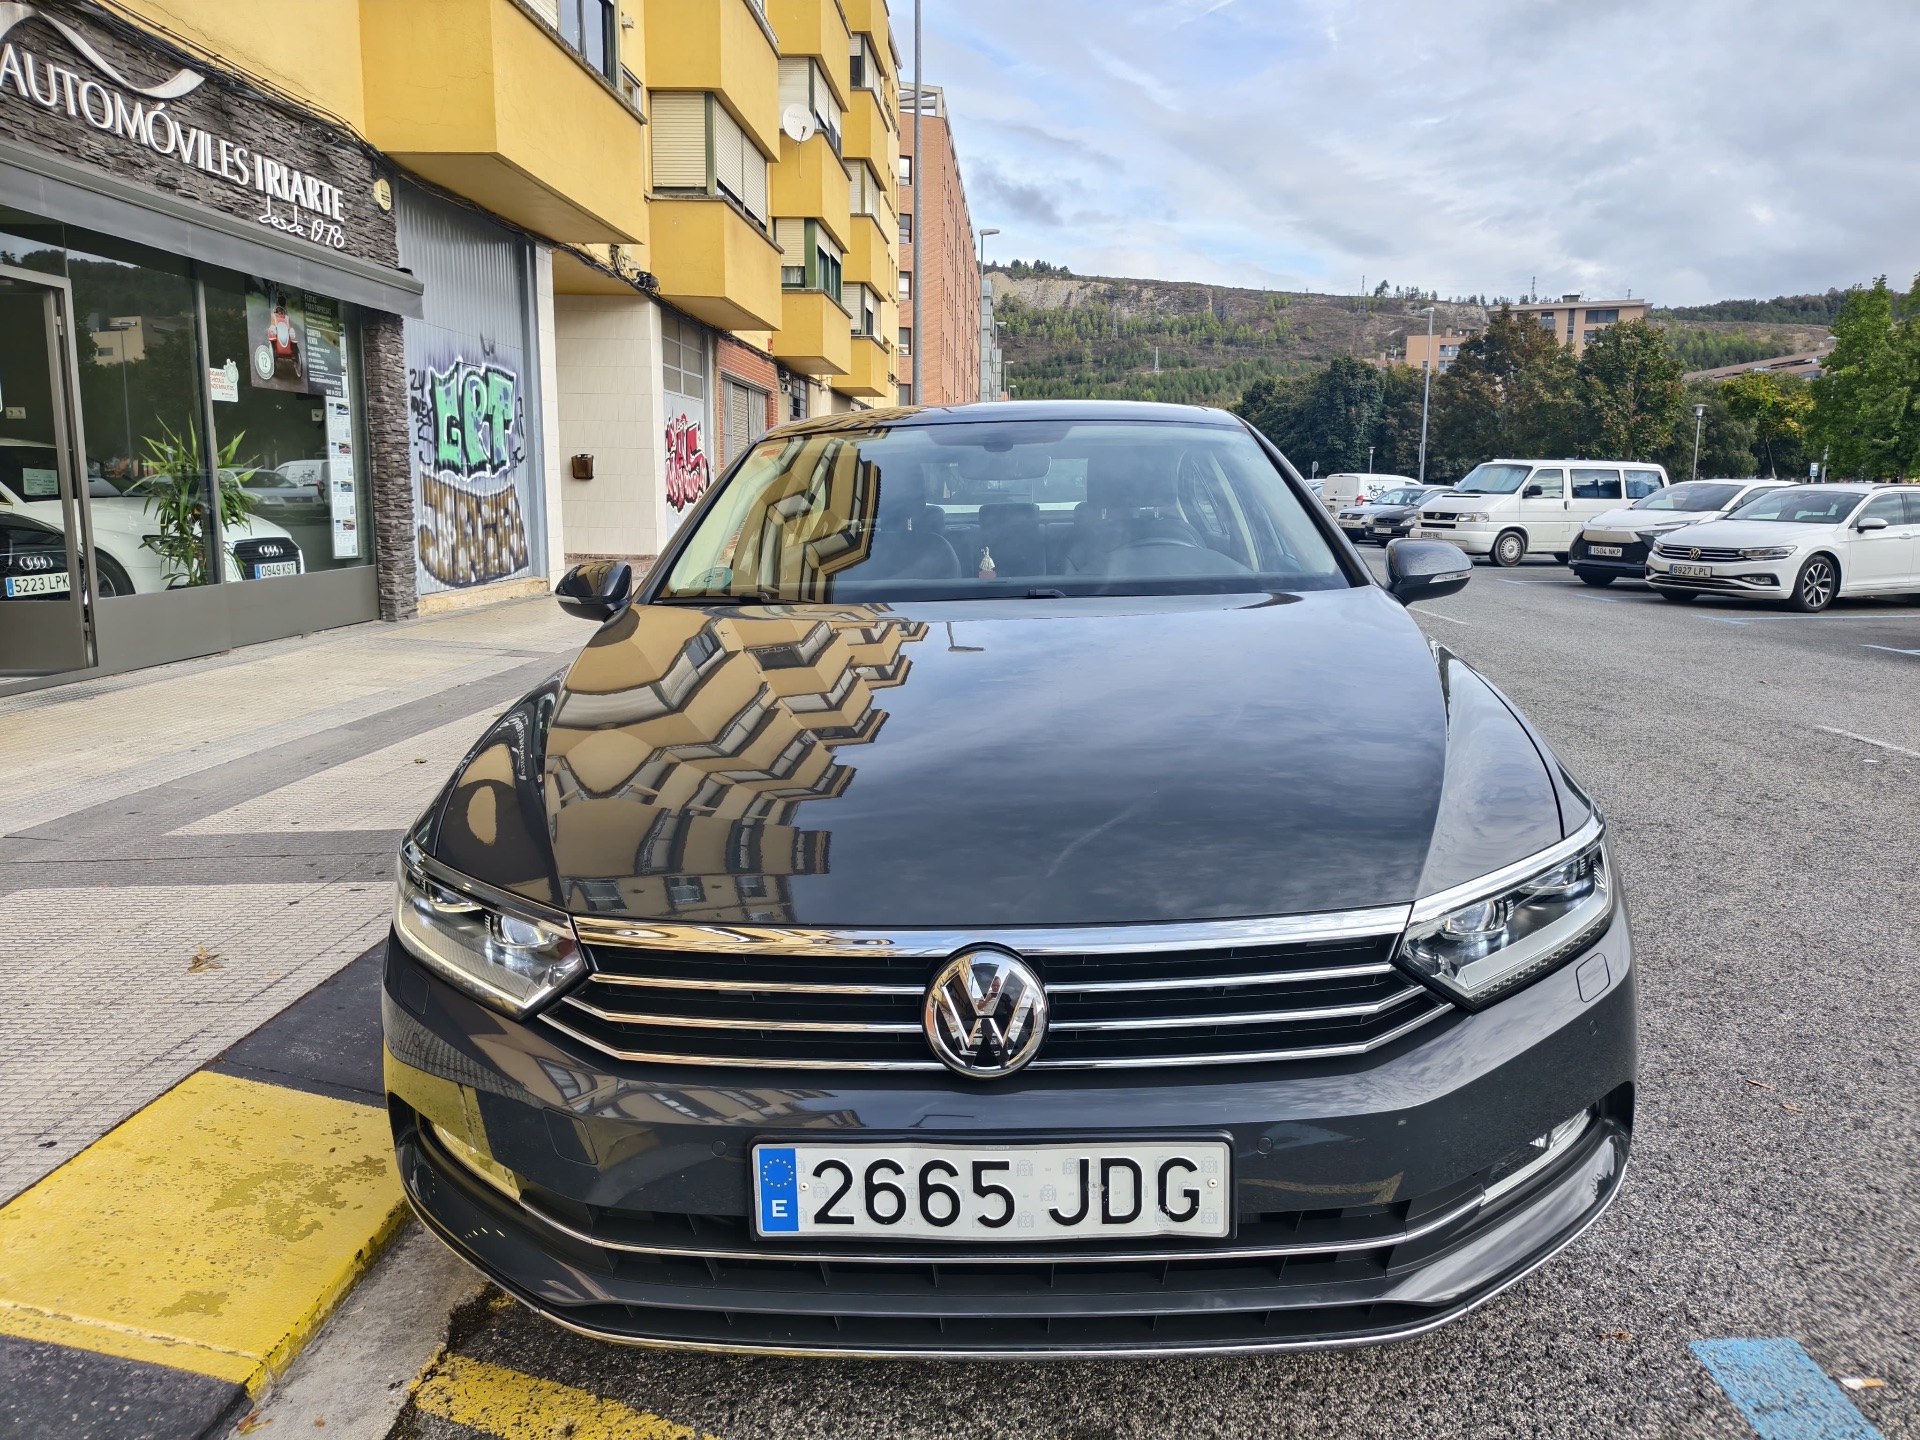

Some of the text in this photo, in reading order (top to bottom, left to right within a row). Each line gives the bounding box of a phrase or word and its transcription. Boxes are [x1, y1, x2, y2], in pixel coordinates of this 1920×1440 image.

[0, 43, 345, 222] AUTOMÓVILES IRIARTE
[258, 195, 345, 248] desde 1978
[261, 355, 268, 368] 12
[1608, 548, 1621, 556] NKP
[261, 563, 294, 577] 0949 KST
[1673, 564, 1708, 576] 6927 LPL
[14, 574, 70, 593] 5223 LPK
[771, 1157, 1201, 1228] E 2665 JDG
